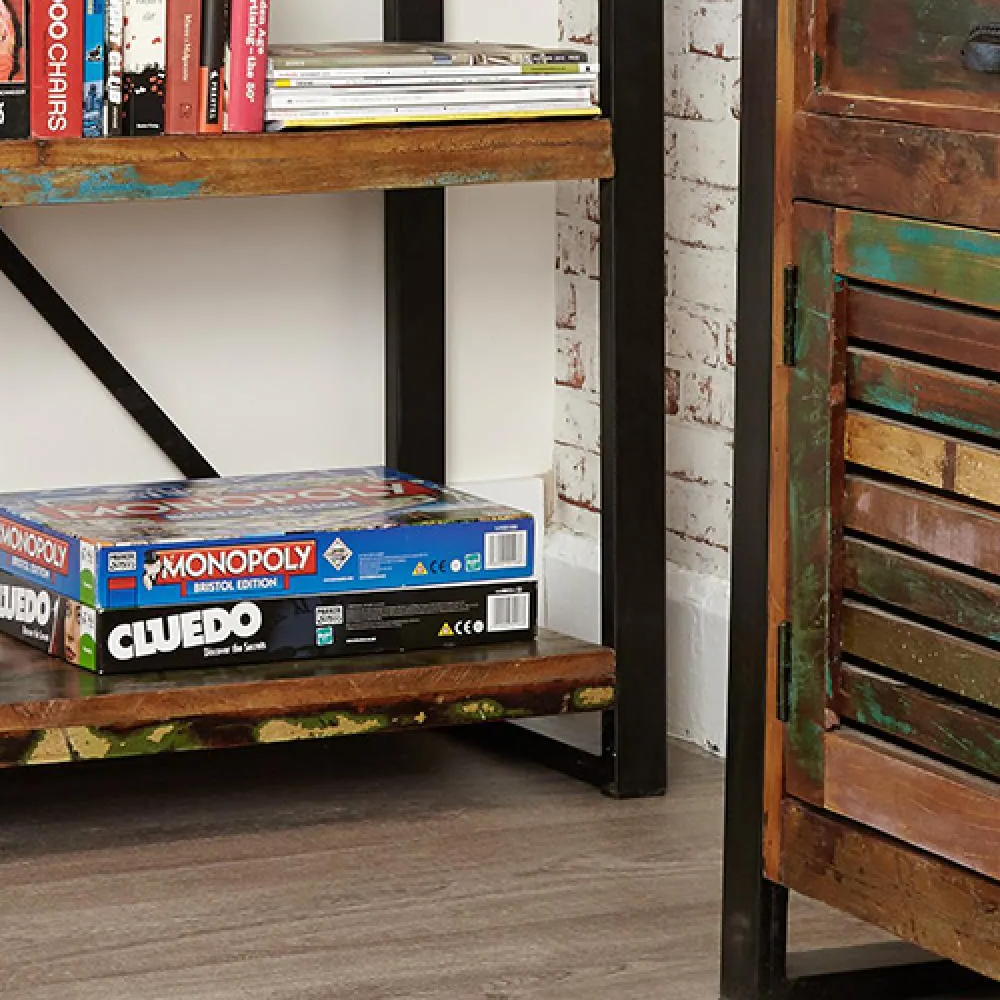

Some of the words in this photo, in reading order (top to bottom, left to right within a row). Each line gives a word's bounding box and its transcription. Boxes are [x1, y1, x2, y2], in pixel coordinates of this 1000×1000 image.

[256, 28, 267, 55] Age
[47, 43, 68, 131] CHAIRS
[1, 521, 67, 569] MONOPOLY
[161, 545, 311, 580] MONOPOLY
[193, 580, 234, 593] BRISTOL
[237, 577, 277, 590] EDITION
[107, 601, 263, 661] CLUEDO
